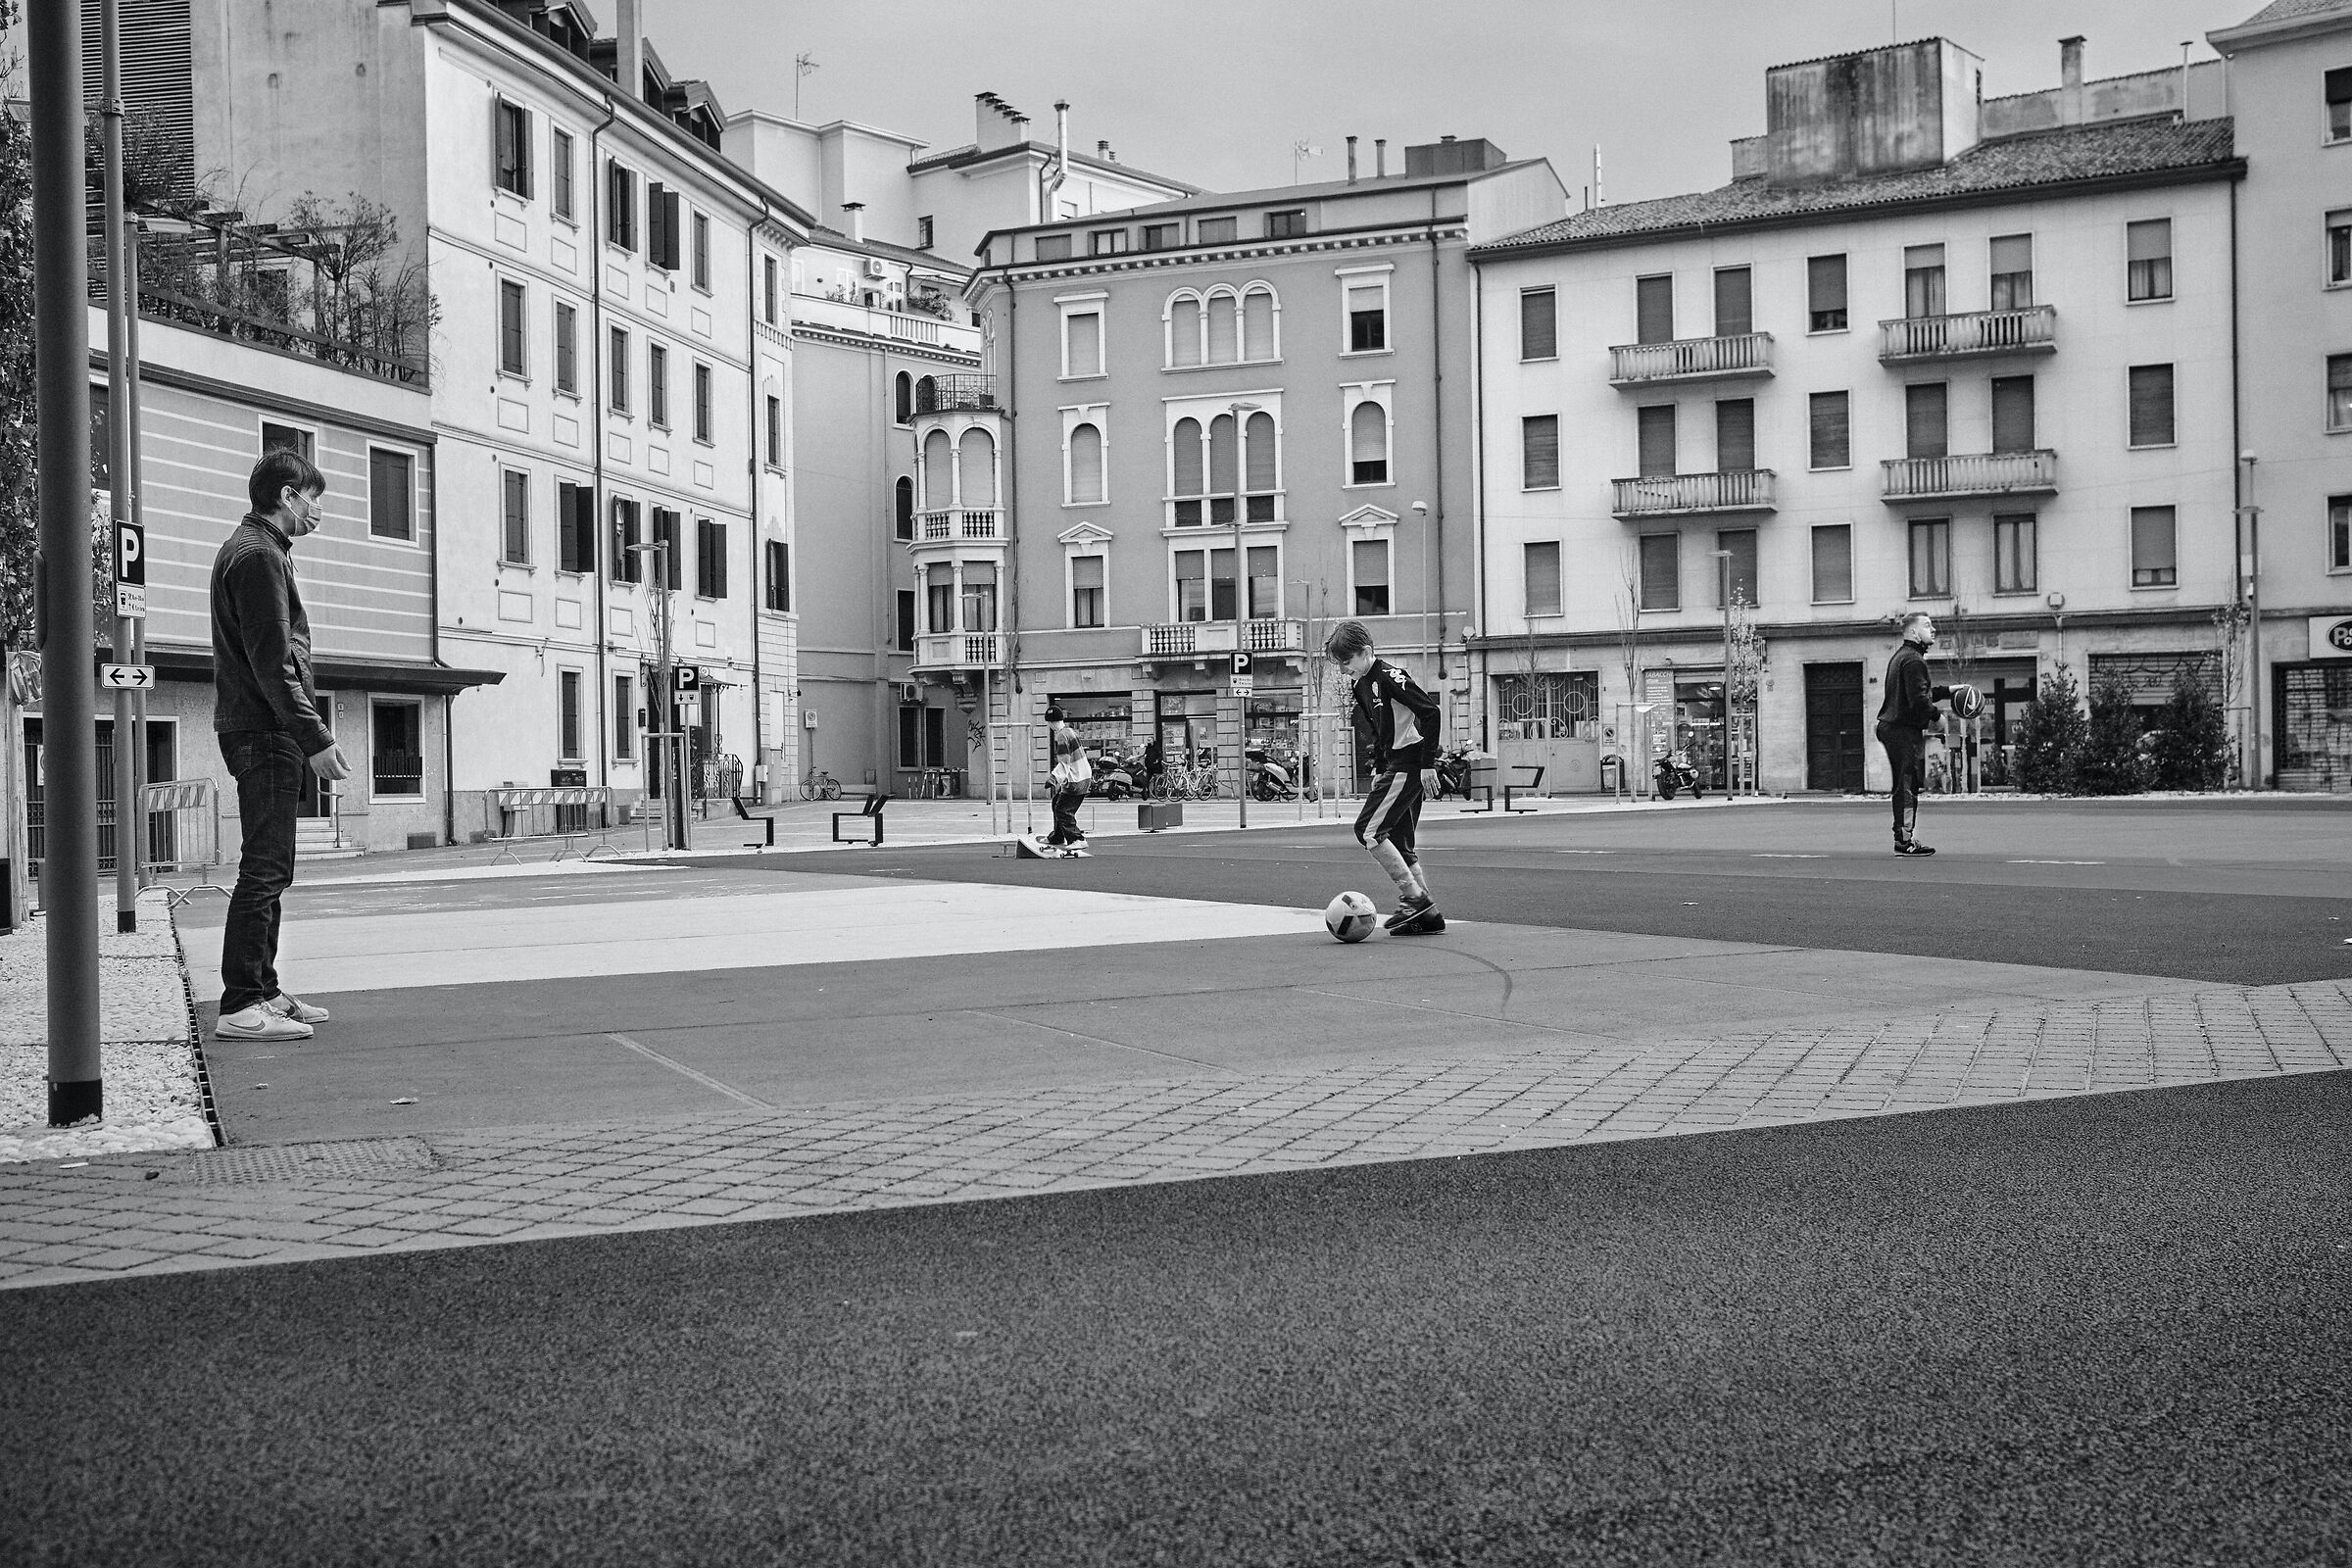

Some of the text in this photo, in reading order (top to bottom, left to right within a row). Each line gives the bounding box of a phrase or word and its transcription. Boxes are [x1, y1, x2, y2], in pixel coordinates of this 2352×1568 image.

[122, 527, 139, 578] P
[1234, 654, 1250, 673] P
[678, 667, 695, 689] P
[1645, 670, 1674, 679] TABACCHI
